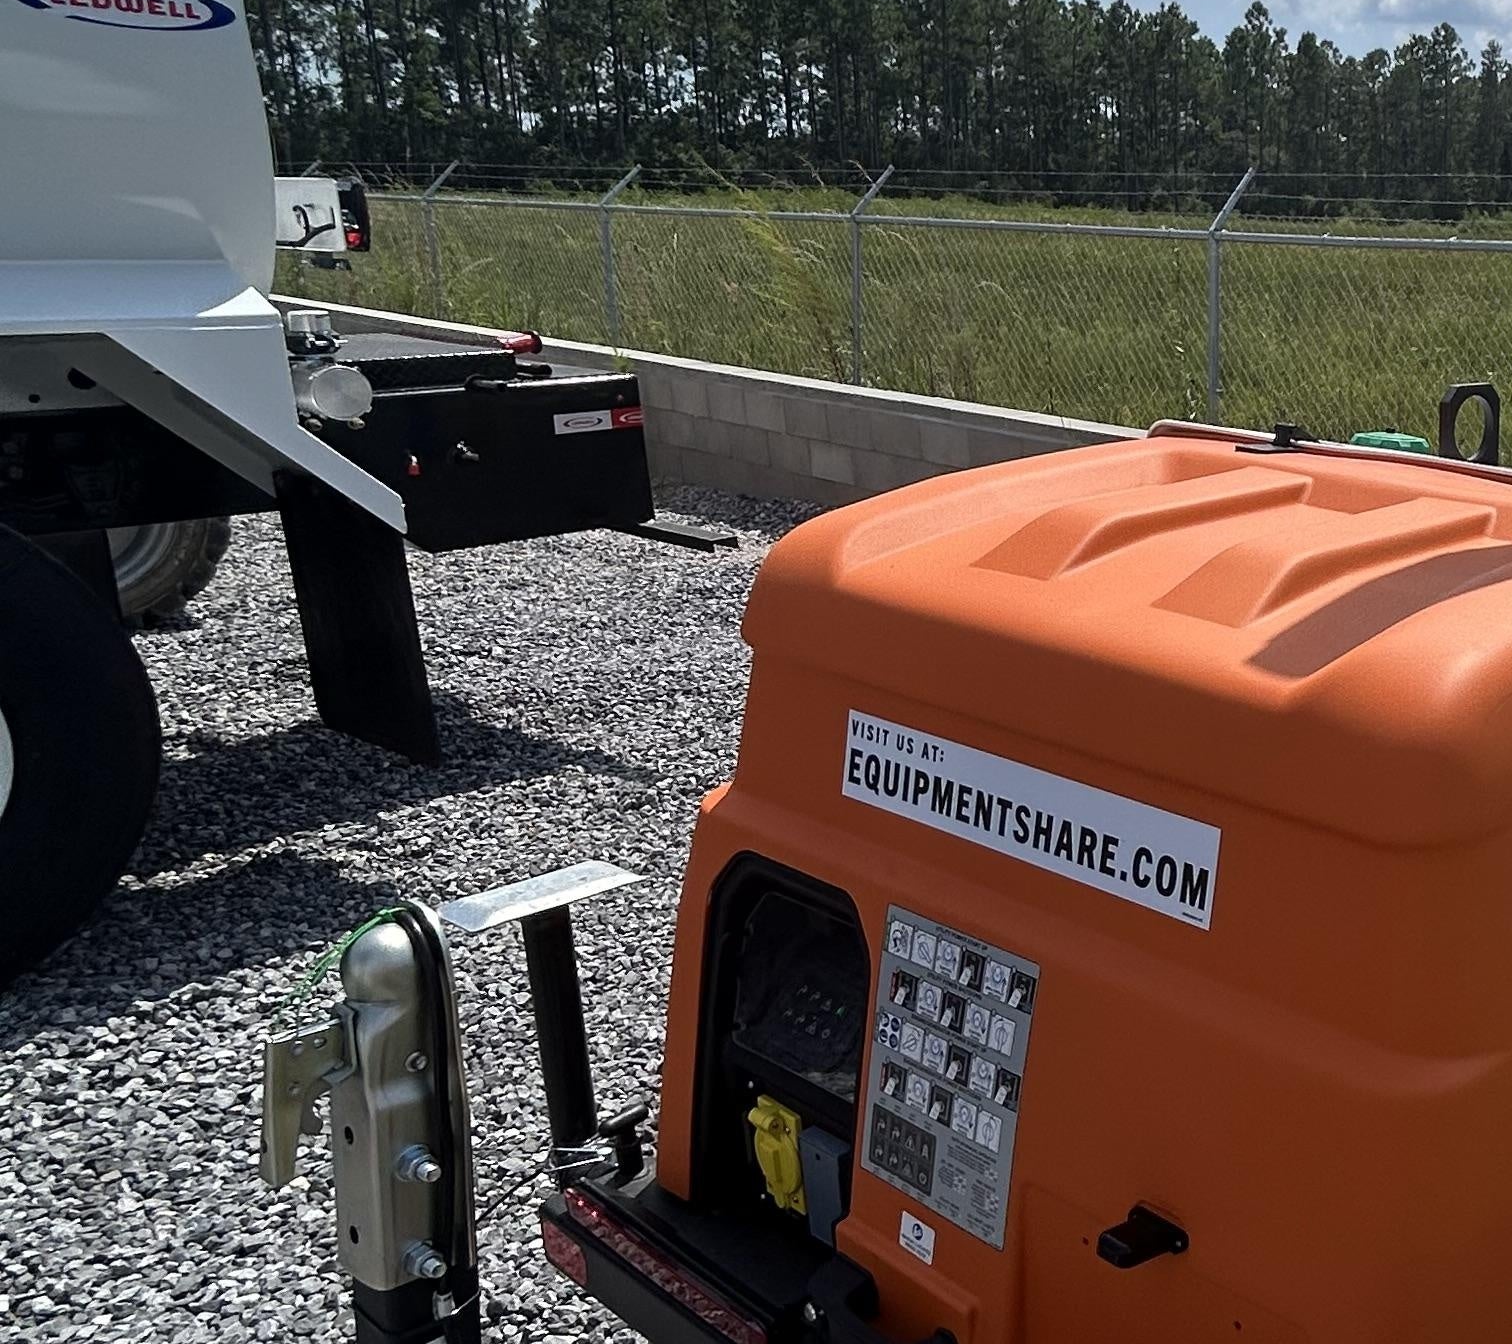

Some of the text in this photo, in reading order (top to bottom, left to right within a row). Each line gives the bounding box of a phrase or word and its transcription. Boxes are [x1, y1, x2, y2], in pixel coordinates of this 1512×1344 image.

[851, 719, 945, 763] VISIT US AT:
[847, 747, 1210, 911] EQUIPMENTSHARE.COM
